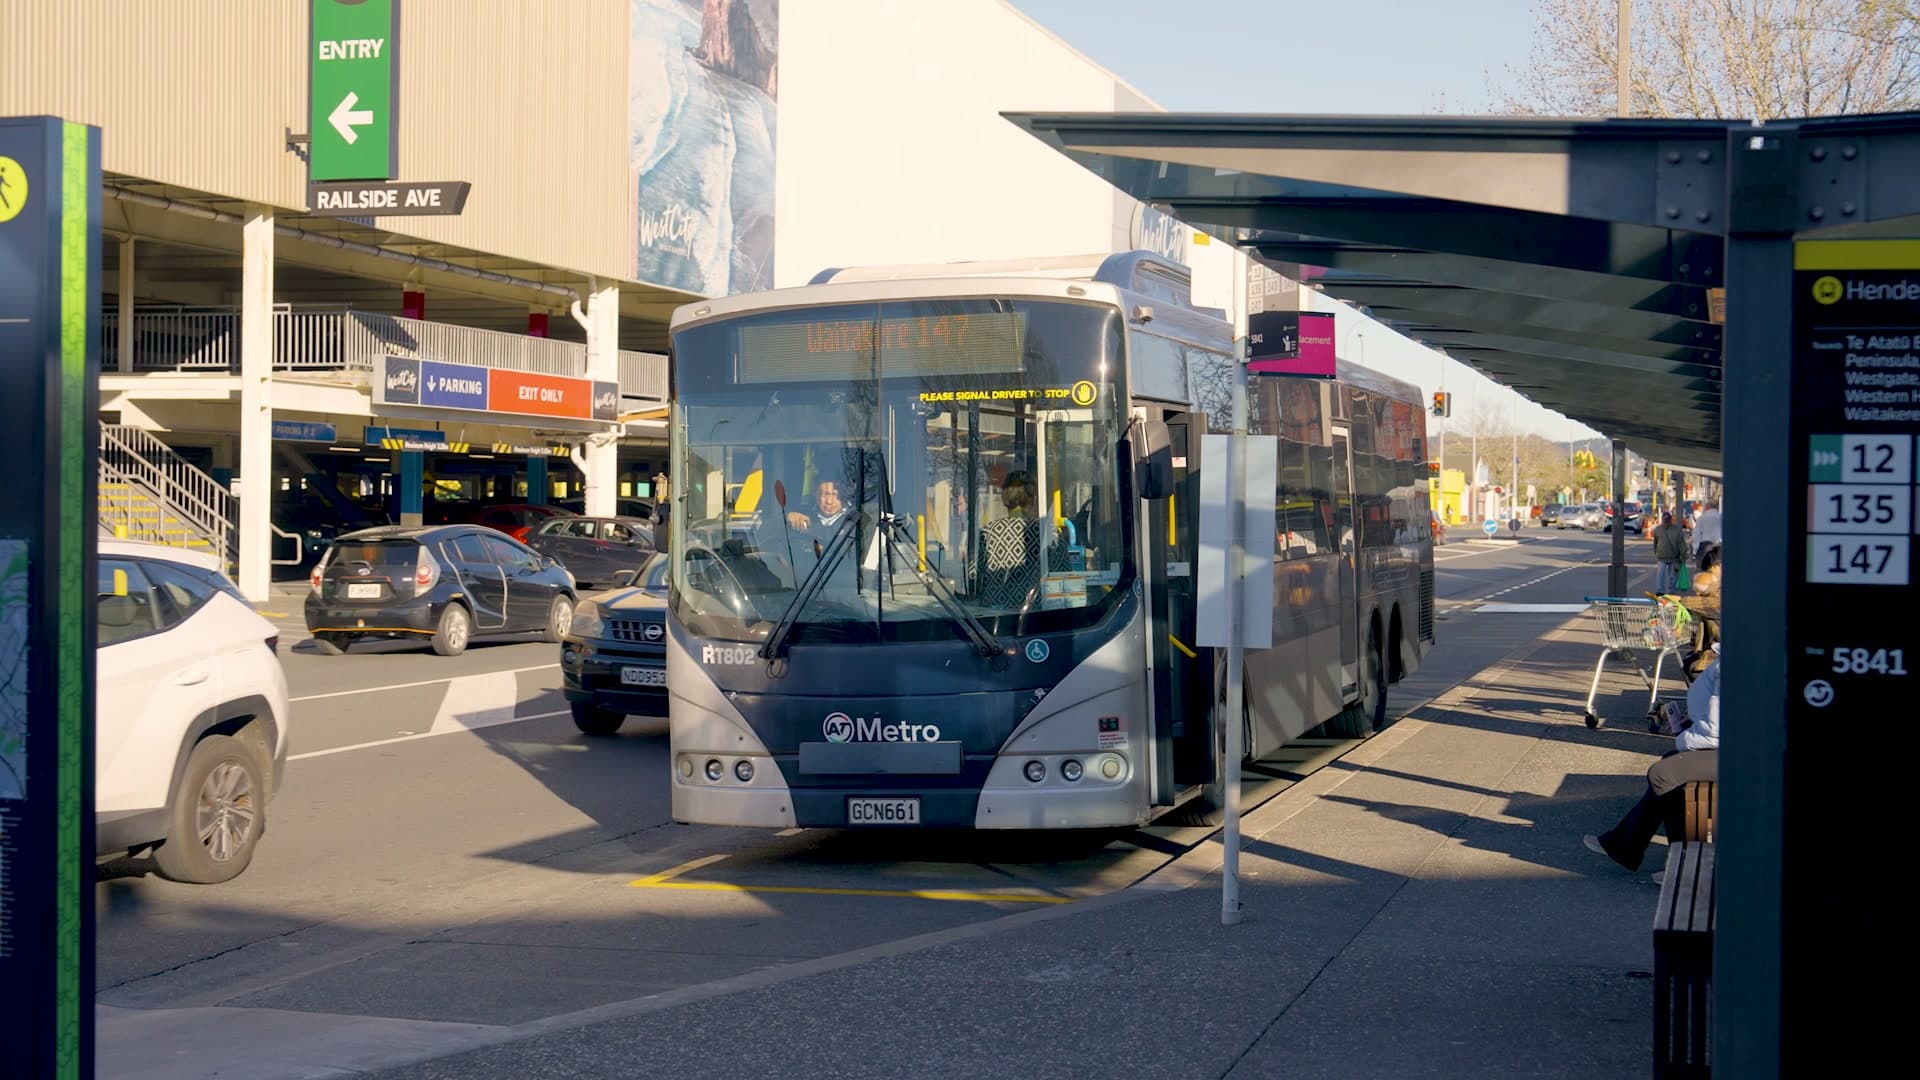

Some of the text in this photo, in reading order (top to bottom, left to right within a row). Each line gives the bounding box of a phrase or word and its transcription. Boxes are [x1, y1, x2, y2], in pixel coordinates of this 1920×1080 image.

[319, 38, 384, 60] ENTRY
[317, 189, 441, 209] RAILSIDE AVE
[1846, 280, 1920, 300] Hende
[917, 313, 970, 347] 147
[1846, 335, 1865, 349] Te
[439, 377, 483, 396] PARKING
[519, 386, 564, 404] EXIT ONLY
[919, 389, 1071, 402] PLEASE SIGNAL DRIVER TO STOP
[1844, 389, 1910, 403] Western
[1851, 444, 1895, 473] 12
[1829, 494, 1895, 524] 135
[1828, 545, 1895, 575] 147
[702, 645, 756, 665] RT802
[1831, 647, 1908, 675] 5841
[856, 717, 940, 742] Metro
[852, 802, 915, 821] GCN661
